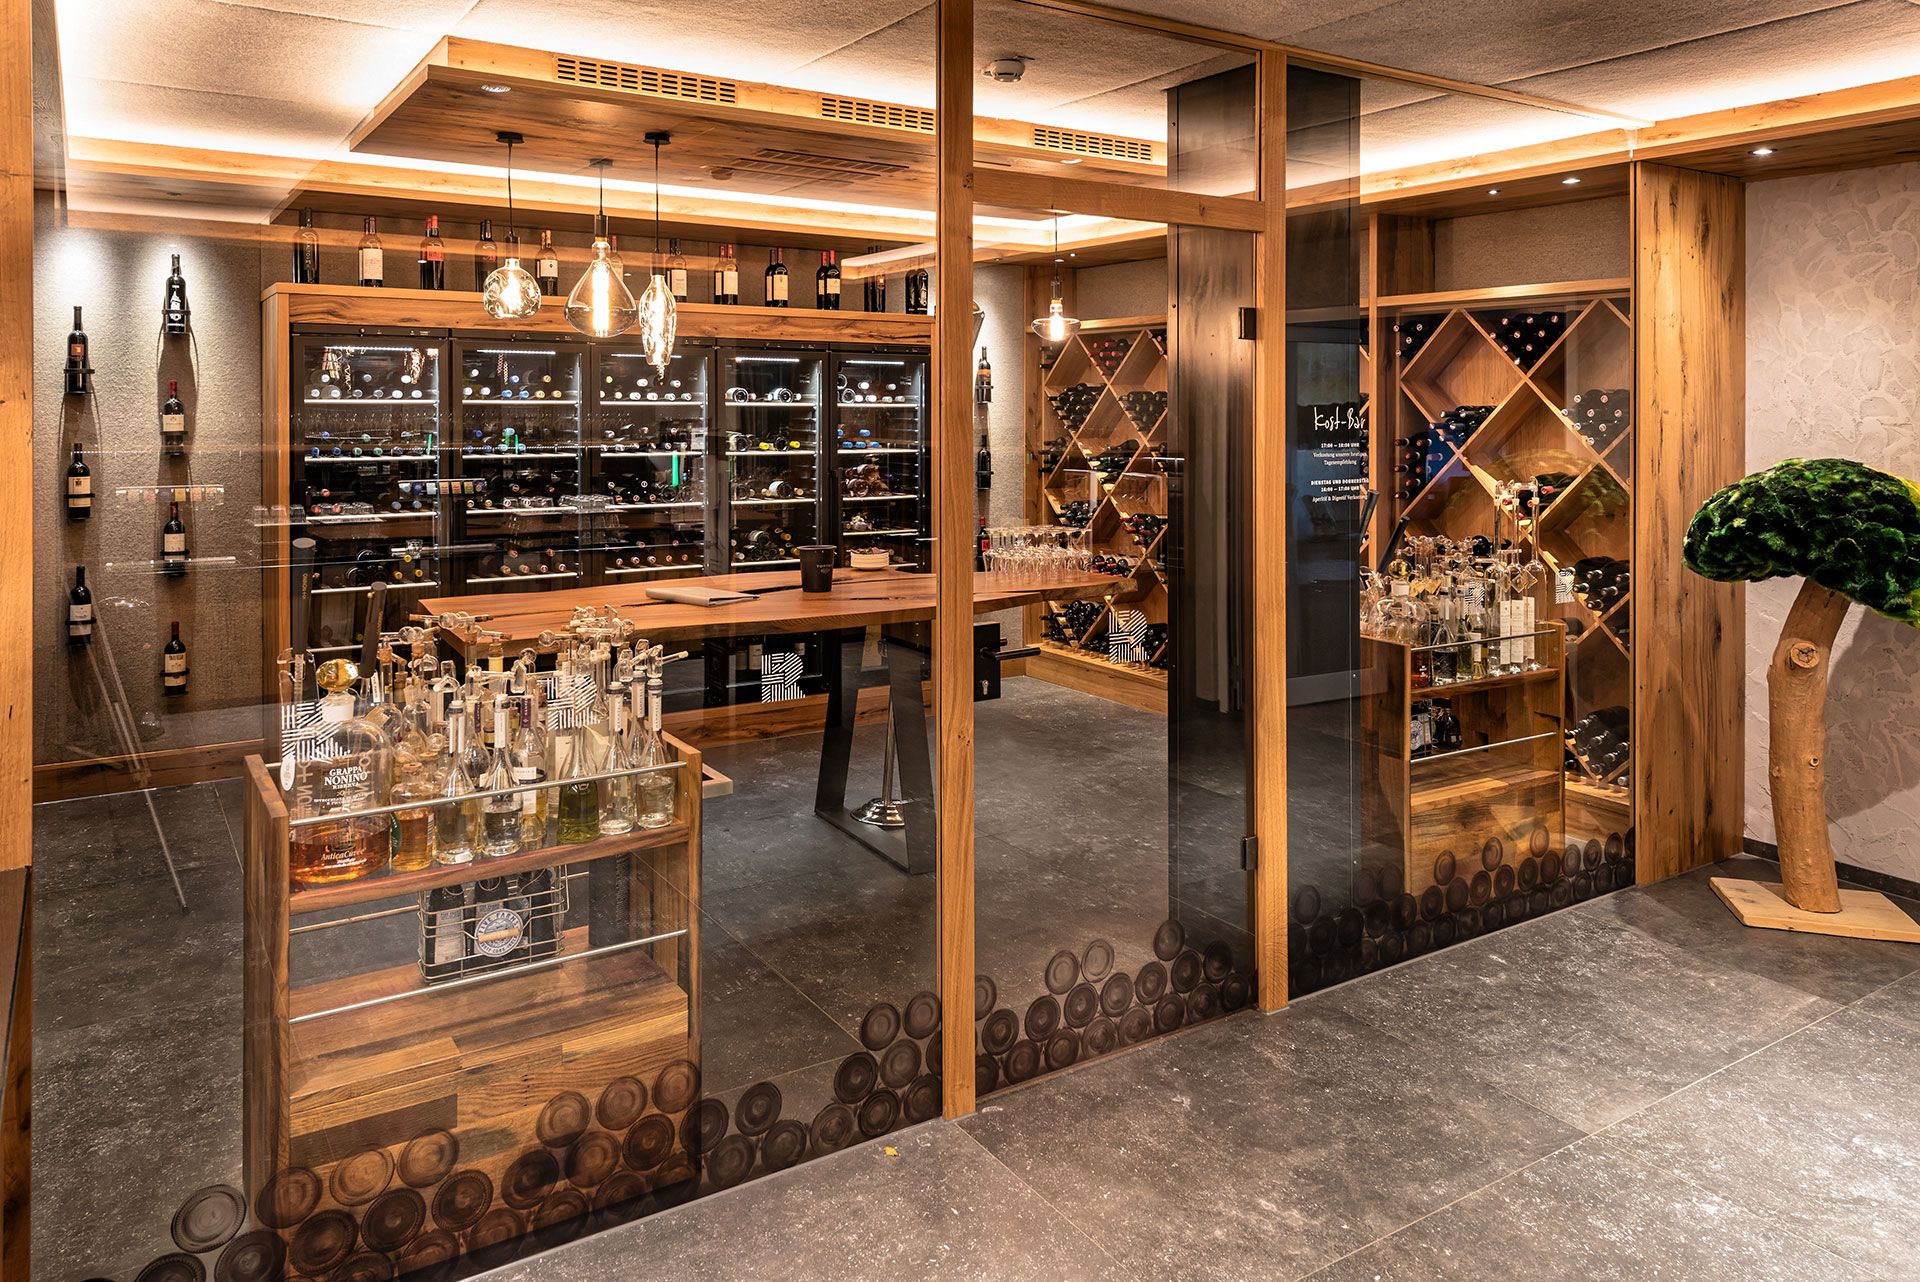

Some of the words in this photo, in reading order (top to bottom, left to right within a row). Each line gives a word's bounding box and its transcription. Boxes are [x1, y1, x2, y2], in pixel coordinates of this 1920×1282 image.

[1314, 406, 1366, 431] Kost-Bar
[324, 771, 368, 786] NONINO
[329, 765, 362, 777] GRAPPA
